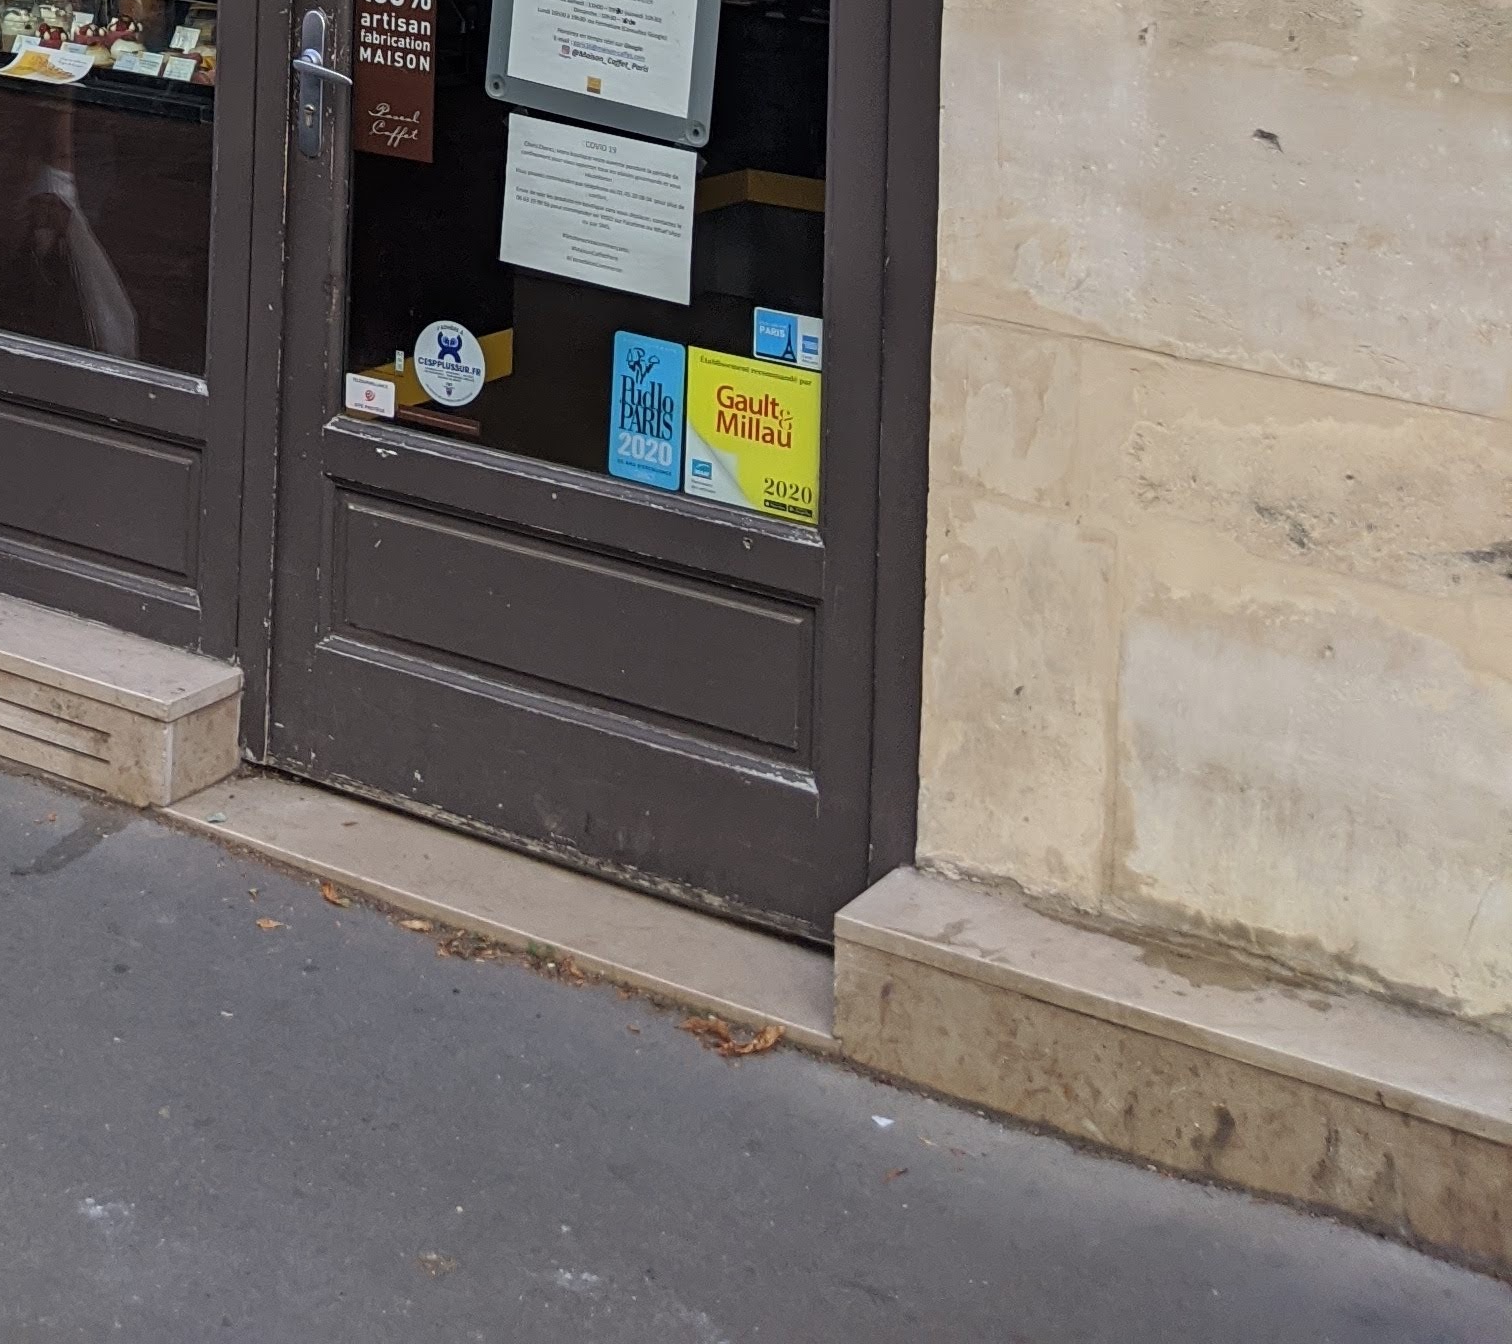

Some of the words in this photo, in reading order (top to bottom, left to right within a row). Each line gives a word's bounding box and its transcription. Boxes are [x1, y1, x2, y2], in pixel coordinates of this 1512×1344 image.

[360, 12, 431, 36] artisan
[360, 29, 431, 53] fabrication
[359, 46, 431, 72] MAISON
[368, 120, 419, 148] Caffet
[618, 400, 674, 442] PARIS
[715, 409, 793, 449] Millau
[616, 432, 674, 467] 2020
[763, 477, 813, 505] 2020
